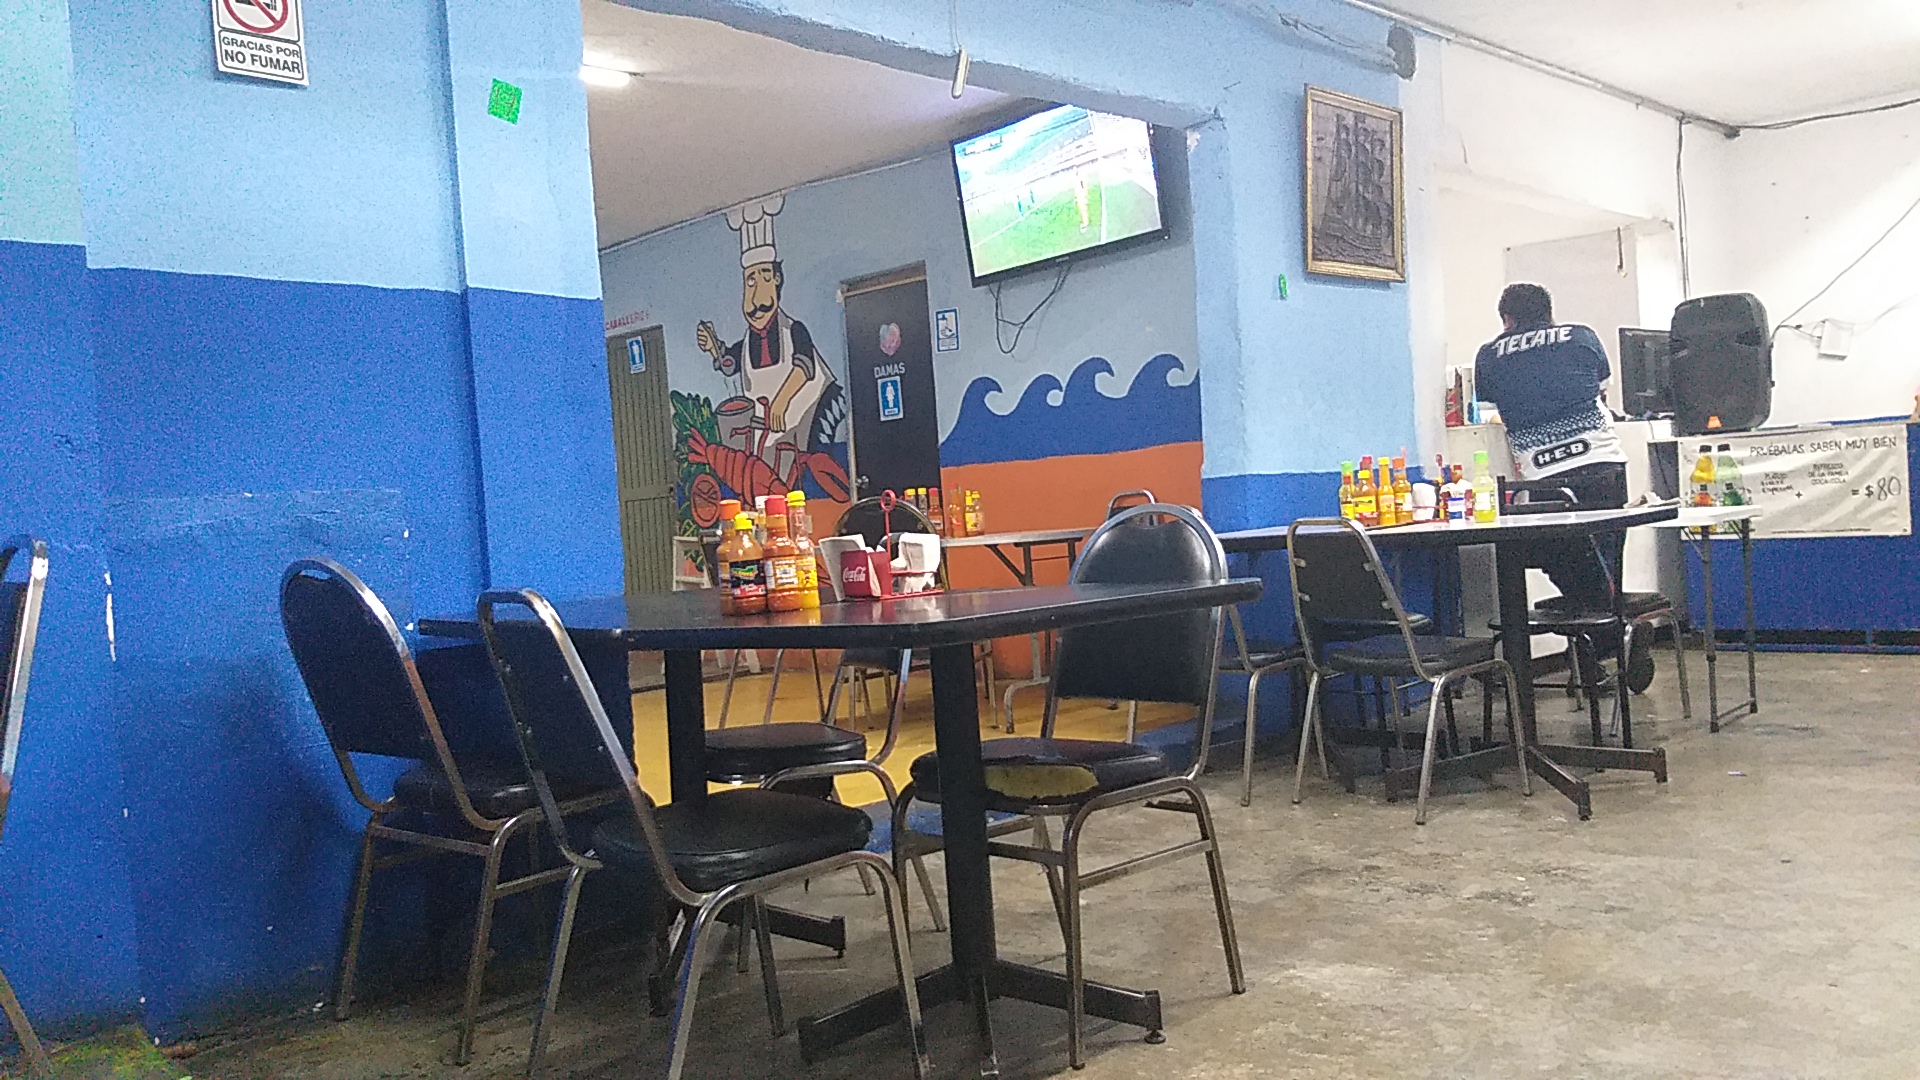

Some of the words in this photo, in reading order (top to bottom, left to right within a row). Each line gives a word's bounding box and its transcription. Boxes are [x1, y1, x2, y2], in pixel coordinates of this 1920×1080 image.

[222, 36, 273, 54] GRACIAS
[276, 46, 300, 59] POR
[224, 48, 246, 64] NO
[250, 53, 301, 74] FUMAR
[1491, 326, 1573, 358] TECATE
[874, 362, 906, 379] DAMAS
[1810, 440, 1841, 453] SABEN
[1846, 438, 1868, 450] MUY
[1873, 436, 1896, 448] BIEN
